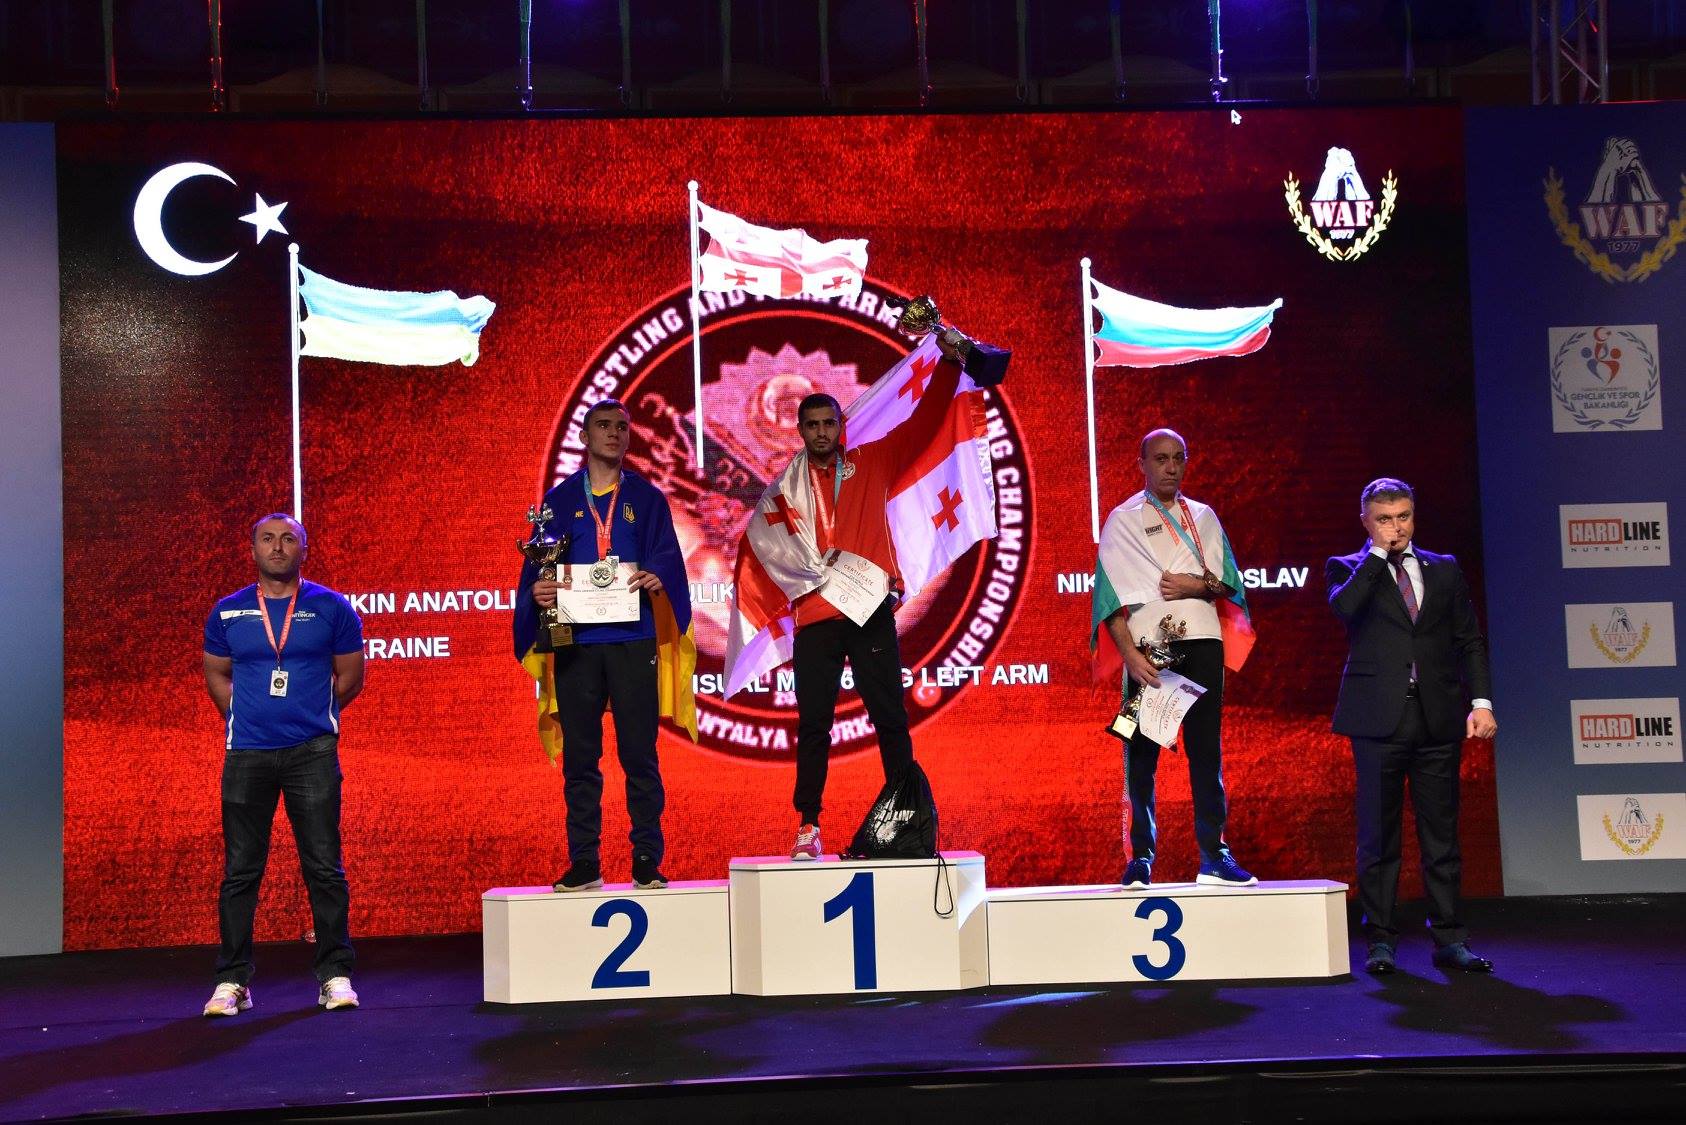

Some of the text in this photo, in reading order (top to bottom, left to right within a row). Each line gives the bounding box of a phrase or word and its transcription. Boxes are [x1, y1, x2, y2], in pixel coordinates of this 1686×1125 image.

[1310, 200, 1374, 228] WAF
[1579, 203, 1668, 240] WAF
[1607, 240, 1640, 253] 1977
[1571, 545, 1661, 553] NUTRITION
[343, 593, 396, 615] KIN
[921, 665, 985, 688] LEFT
[991, 663, 1048, 686] ARM
[1617, 825, 1651, 838] WAF
[591, 899, 650, 987] 2
[824, 873, 877, 991] 1
[1132, 897, 1186, 981] 3
